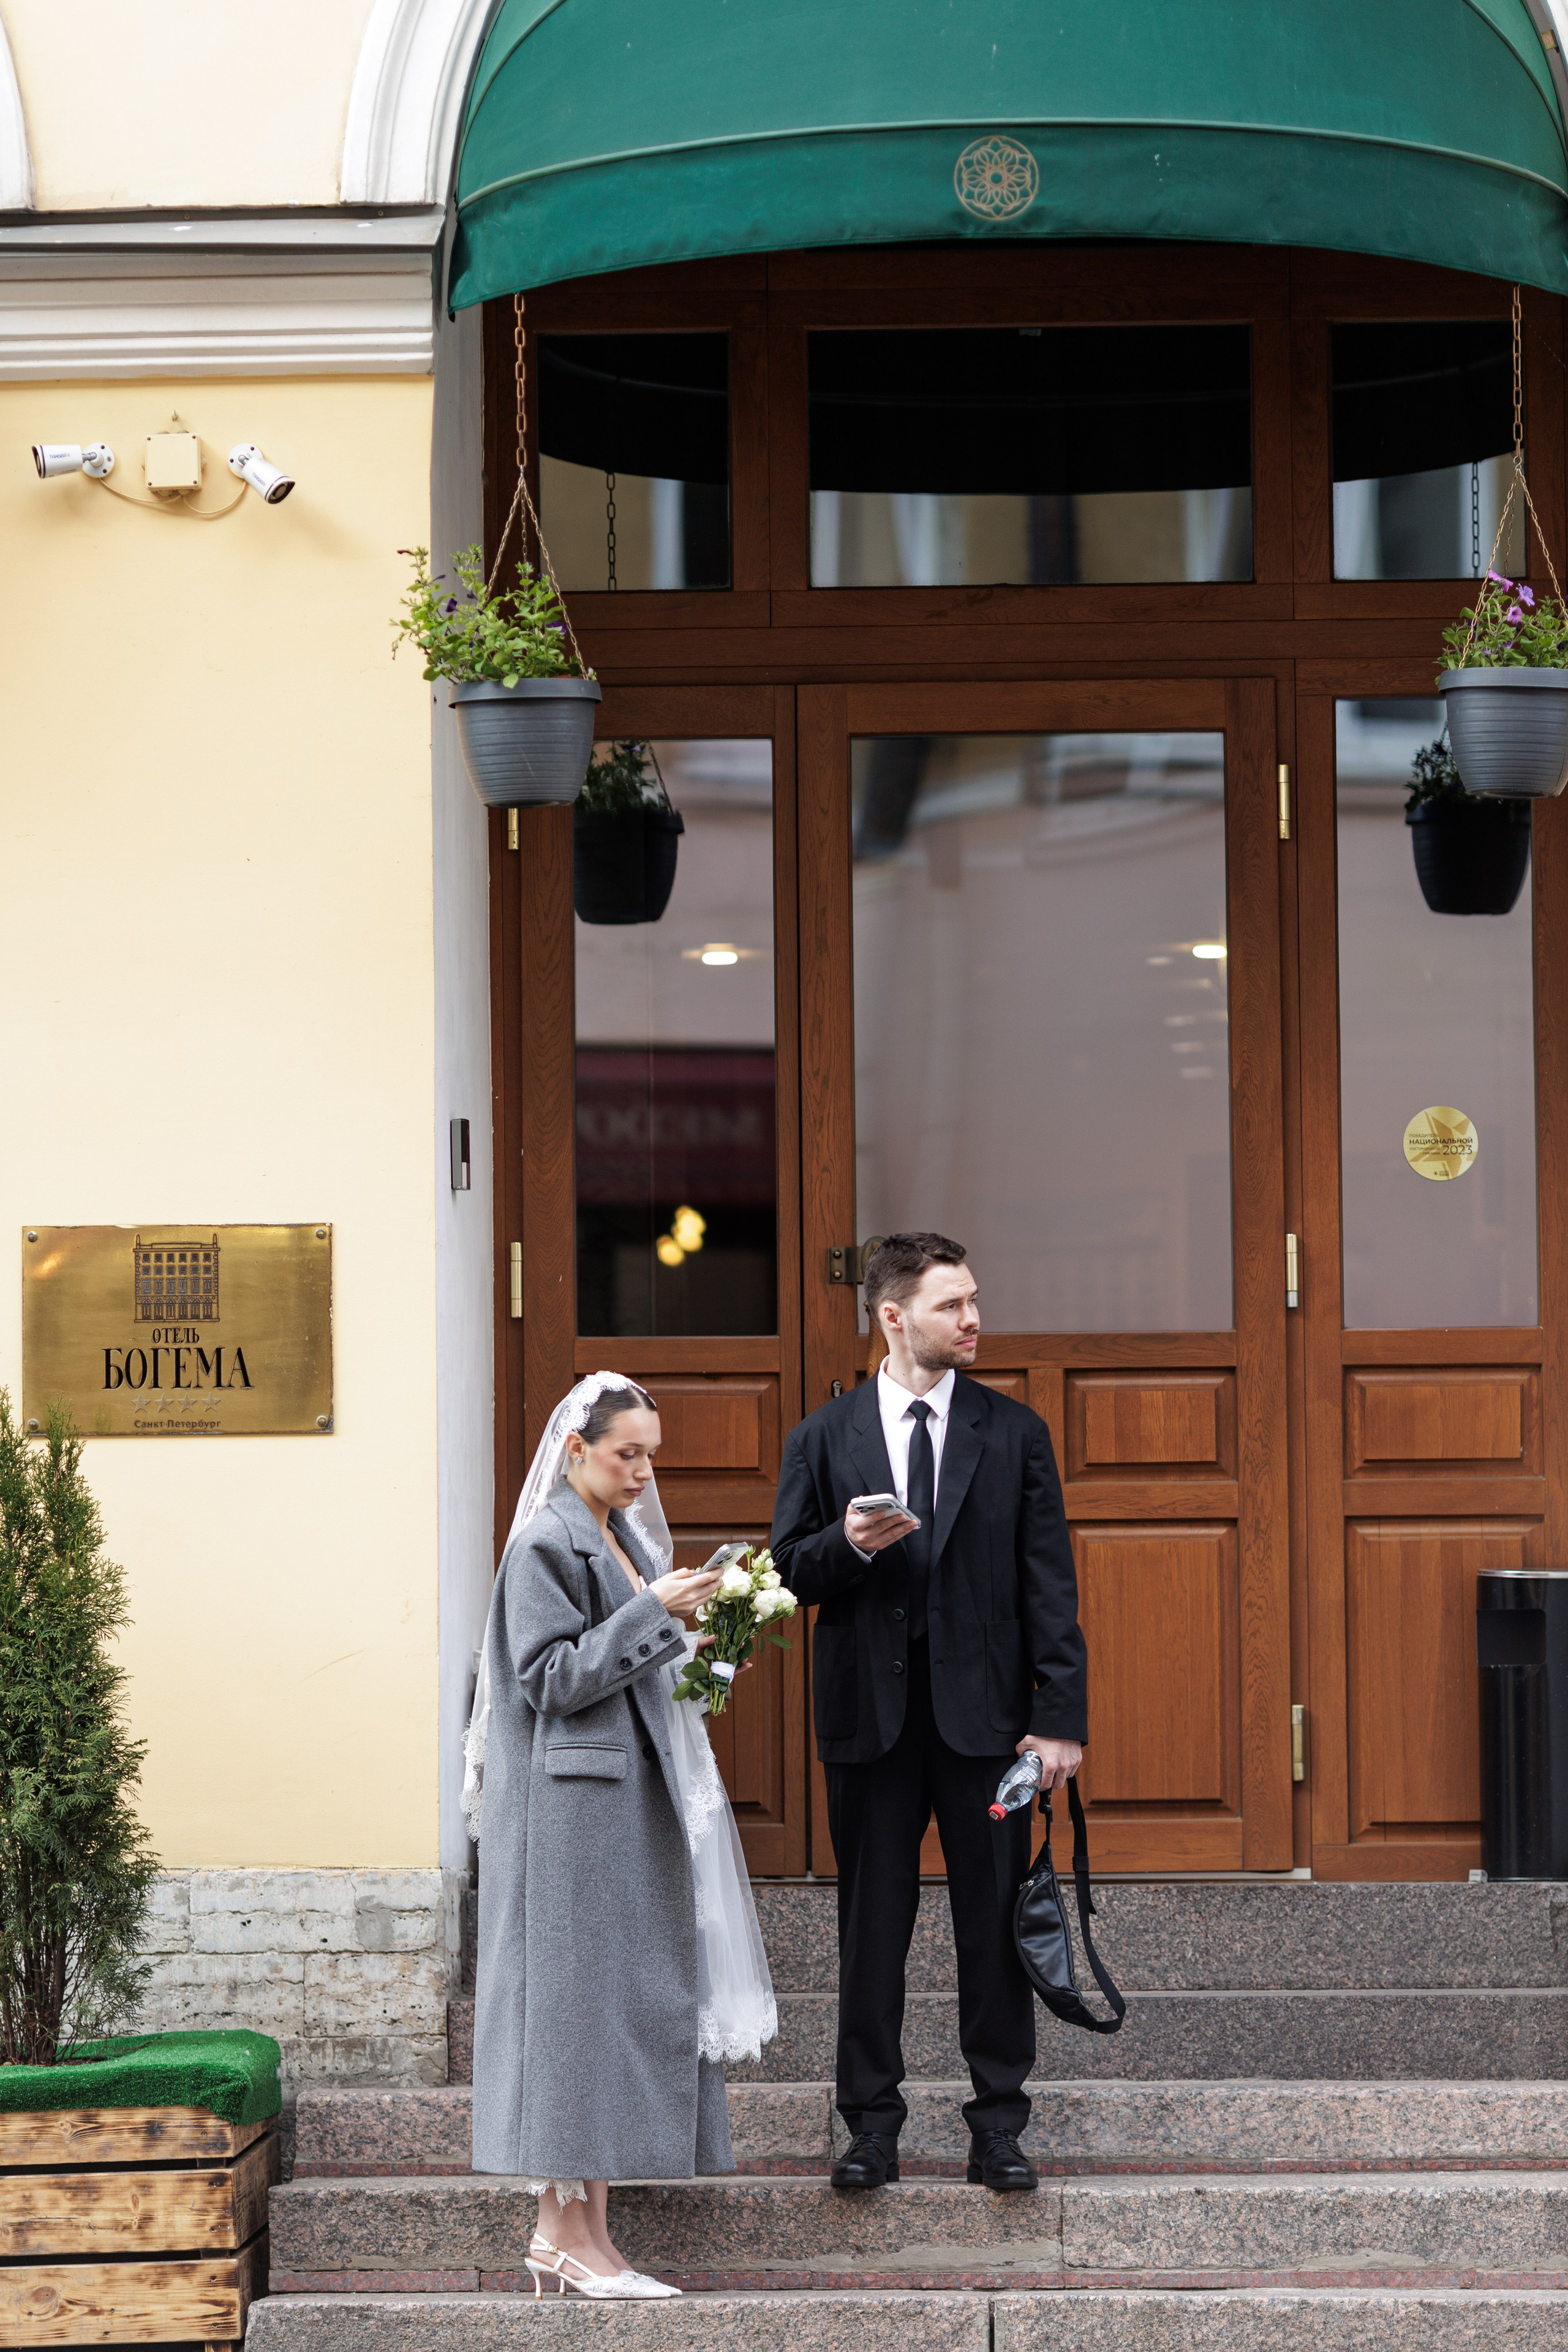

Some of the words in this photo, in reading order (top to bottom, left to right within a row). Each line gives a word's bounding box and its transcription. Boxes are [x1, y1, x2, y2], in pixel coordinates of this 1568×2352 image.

[1442, 1145, 1472, 1155] 2023
[153, 1327, 200, 1343] ОТЕЛЬ
[101, 1347, 254, 1389] БОГЕМА
